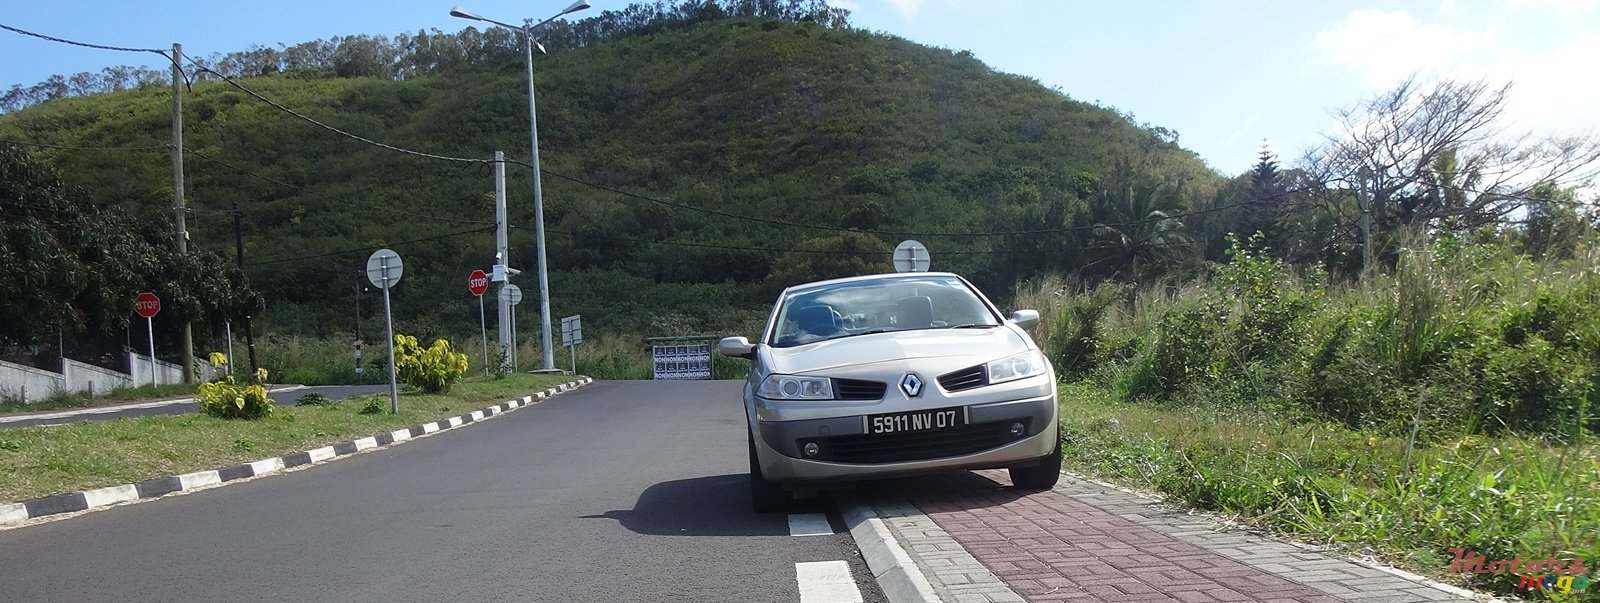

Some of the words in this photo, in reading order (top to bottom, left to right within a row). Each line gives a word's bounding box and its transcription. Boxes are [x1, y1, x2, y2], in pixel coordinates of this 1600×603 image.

[471, 278, 486, 288] STOP
[137, 301, 157, 309] STOP
[874, 415, 908, 433] 5911
[912, 413, 931, 430] NV
[936, 411, 956, 428] 07
